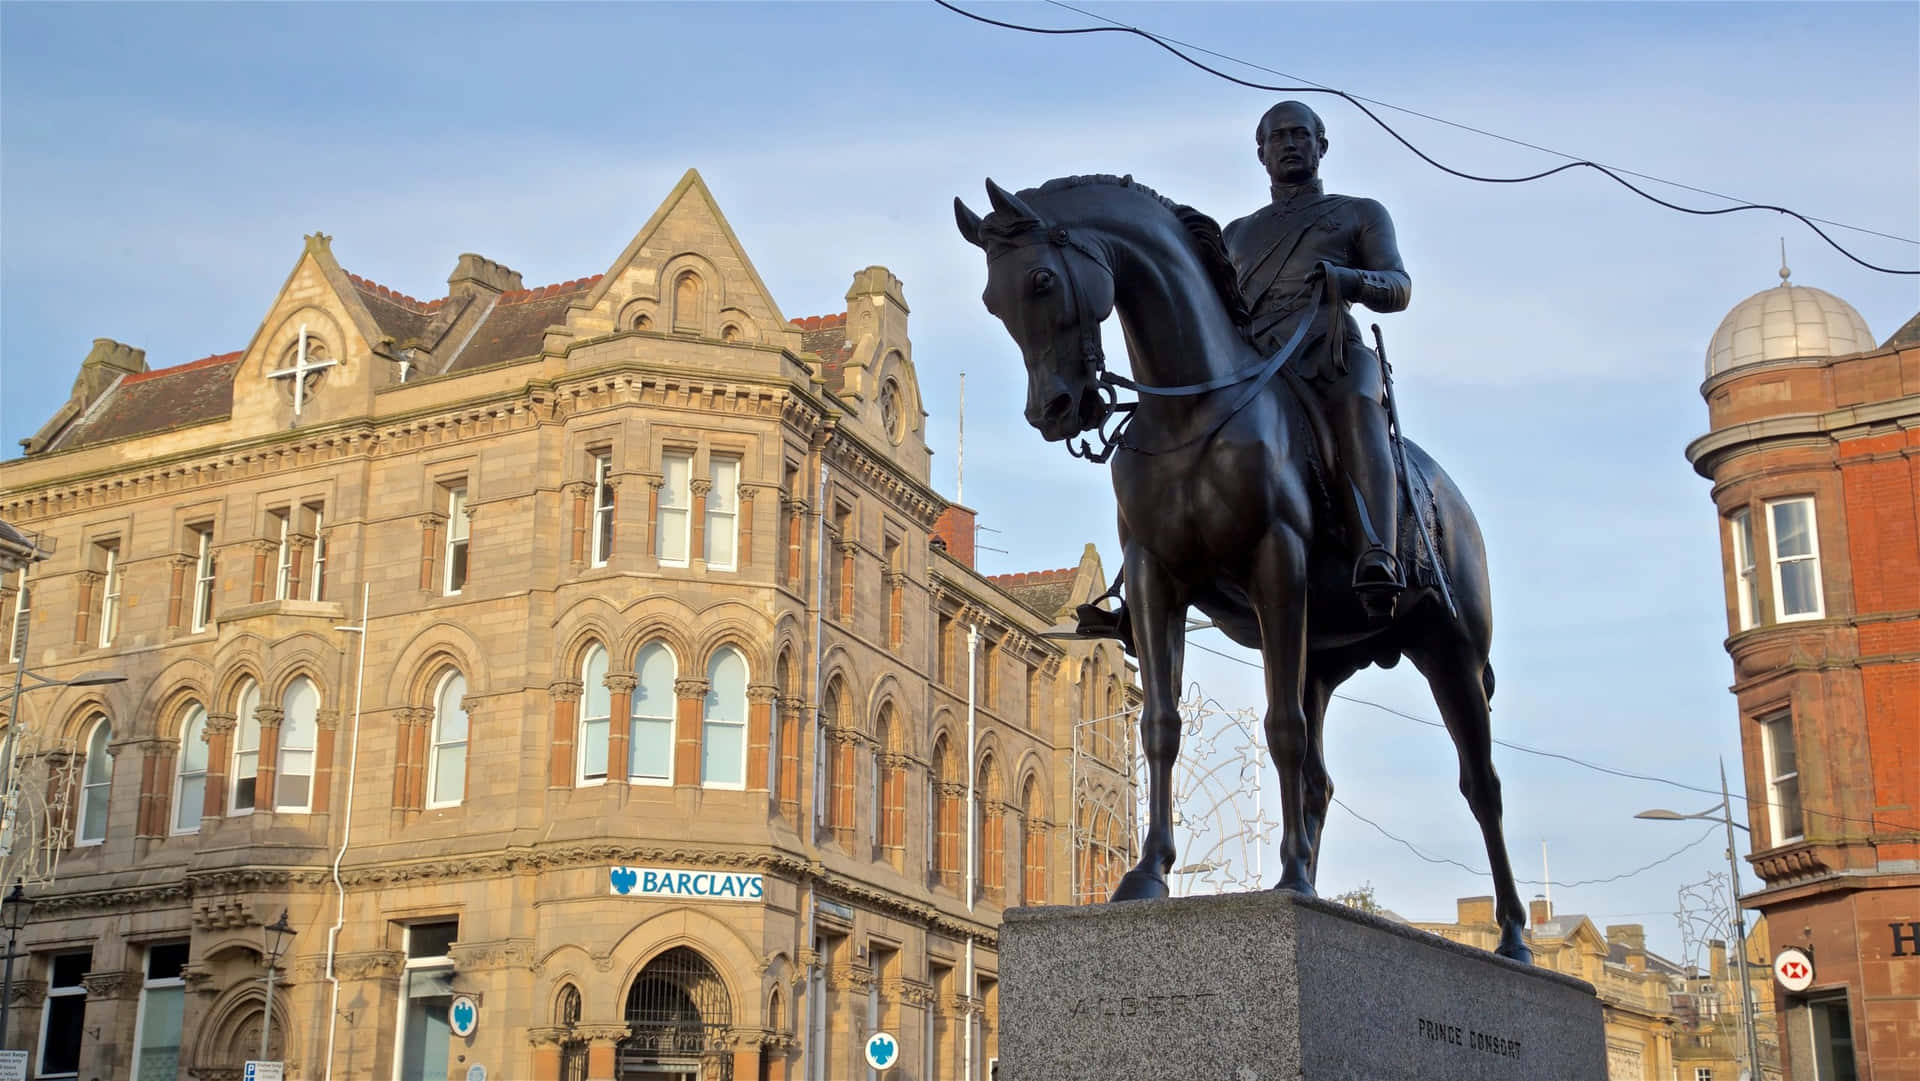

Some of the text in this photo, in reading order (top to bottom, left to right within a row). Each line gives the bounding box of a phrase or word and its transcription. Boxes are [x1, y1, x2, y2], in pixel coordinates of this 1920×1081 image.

[642, 871, 764, 898] BARCLAYS
[1418, 1018, 1521, 1059] PRINCE CONSORT
